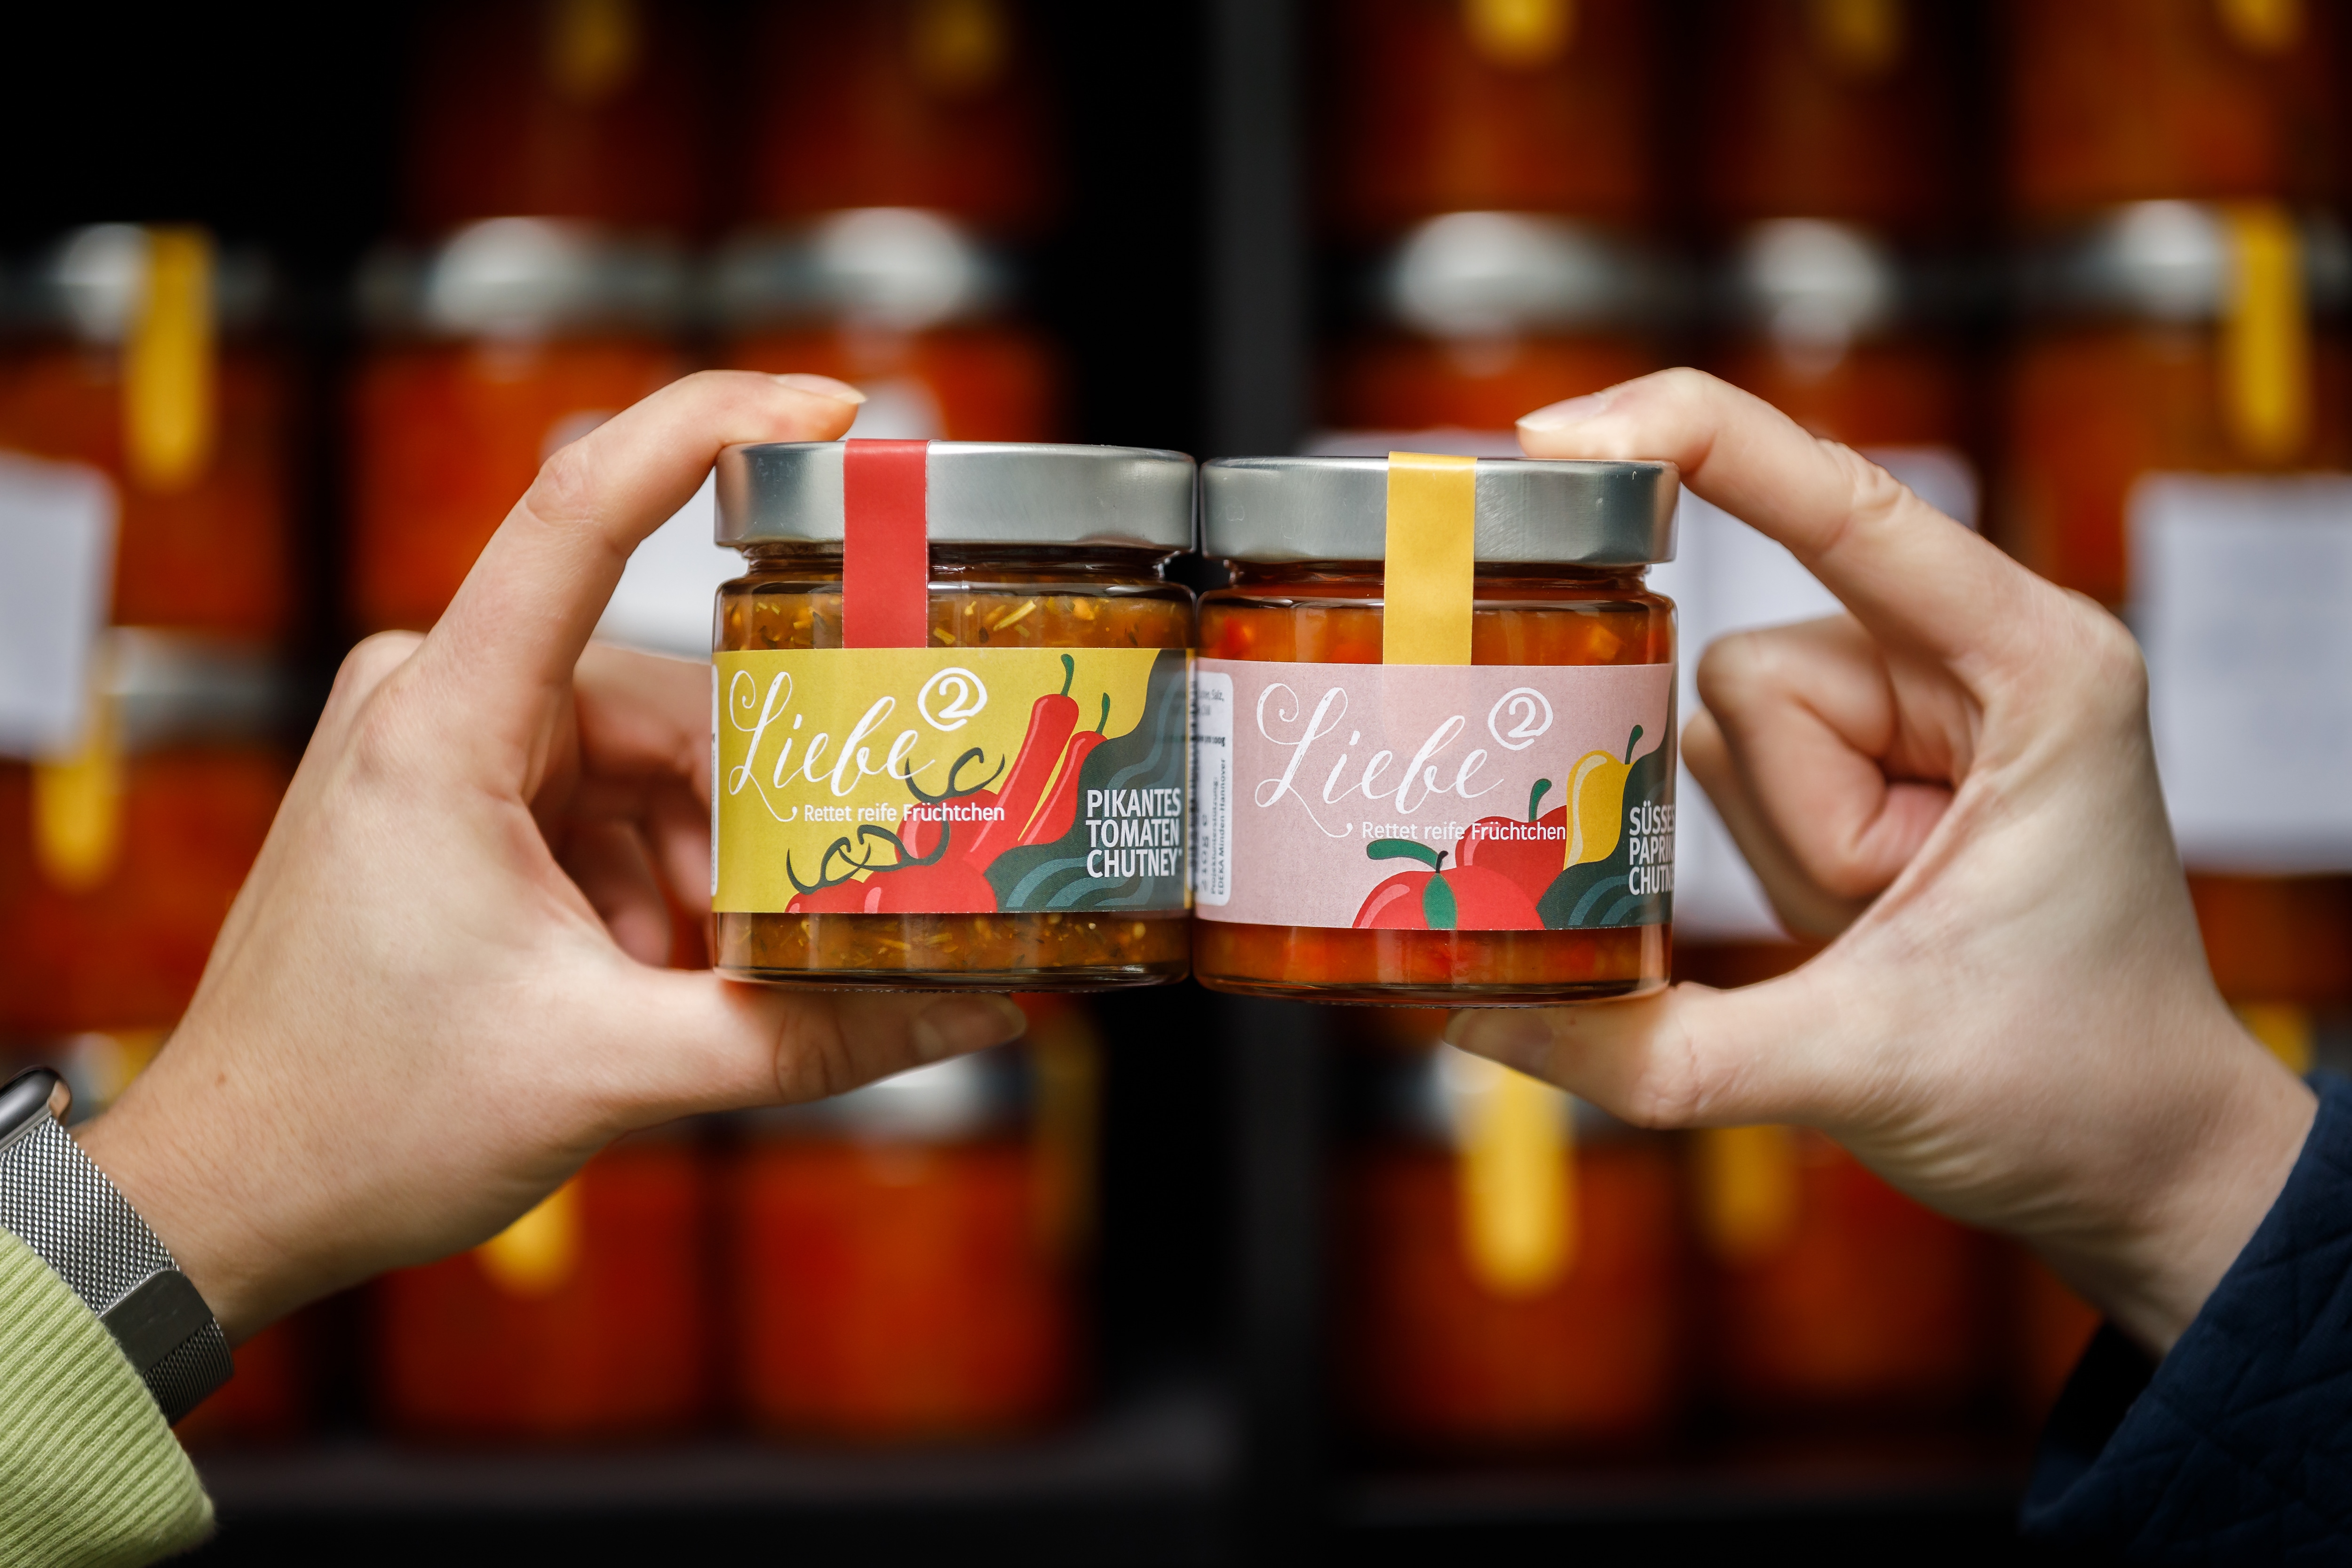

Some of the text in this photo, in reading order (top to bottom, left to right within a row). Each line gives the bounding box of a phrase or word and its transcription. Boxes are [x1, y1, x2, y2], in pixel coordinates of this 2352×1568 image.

[728, 670, 935, 822] Liebe
[1255, 682, 1504, 838] Liebe
[804, 802, 1005, 822] Rettet reife Früchtchen
[1087, 788, 1182, 818] PIKANTES
[1085, 818, 1180, 848] TOMATEN
[1362, 821, 1566, 841] Rettet reife Früchtchen
[1629, 835, 1675, 866] PAPRIK
